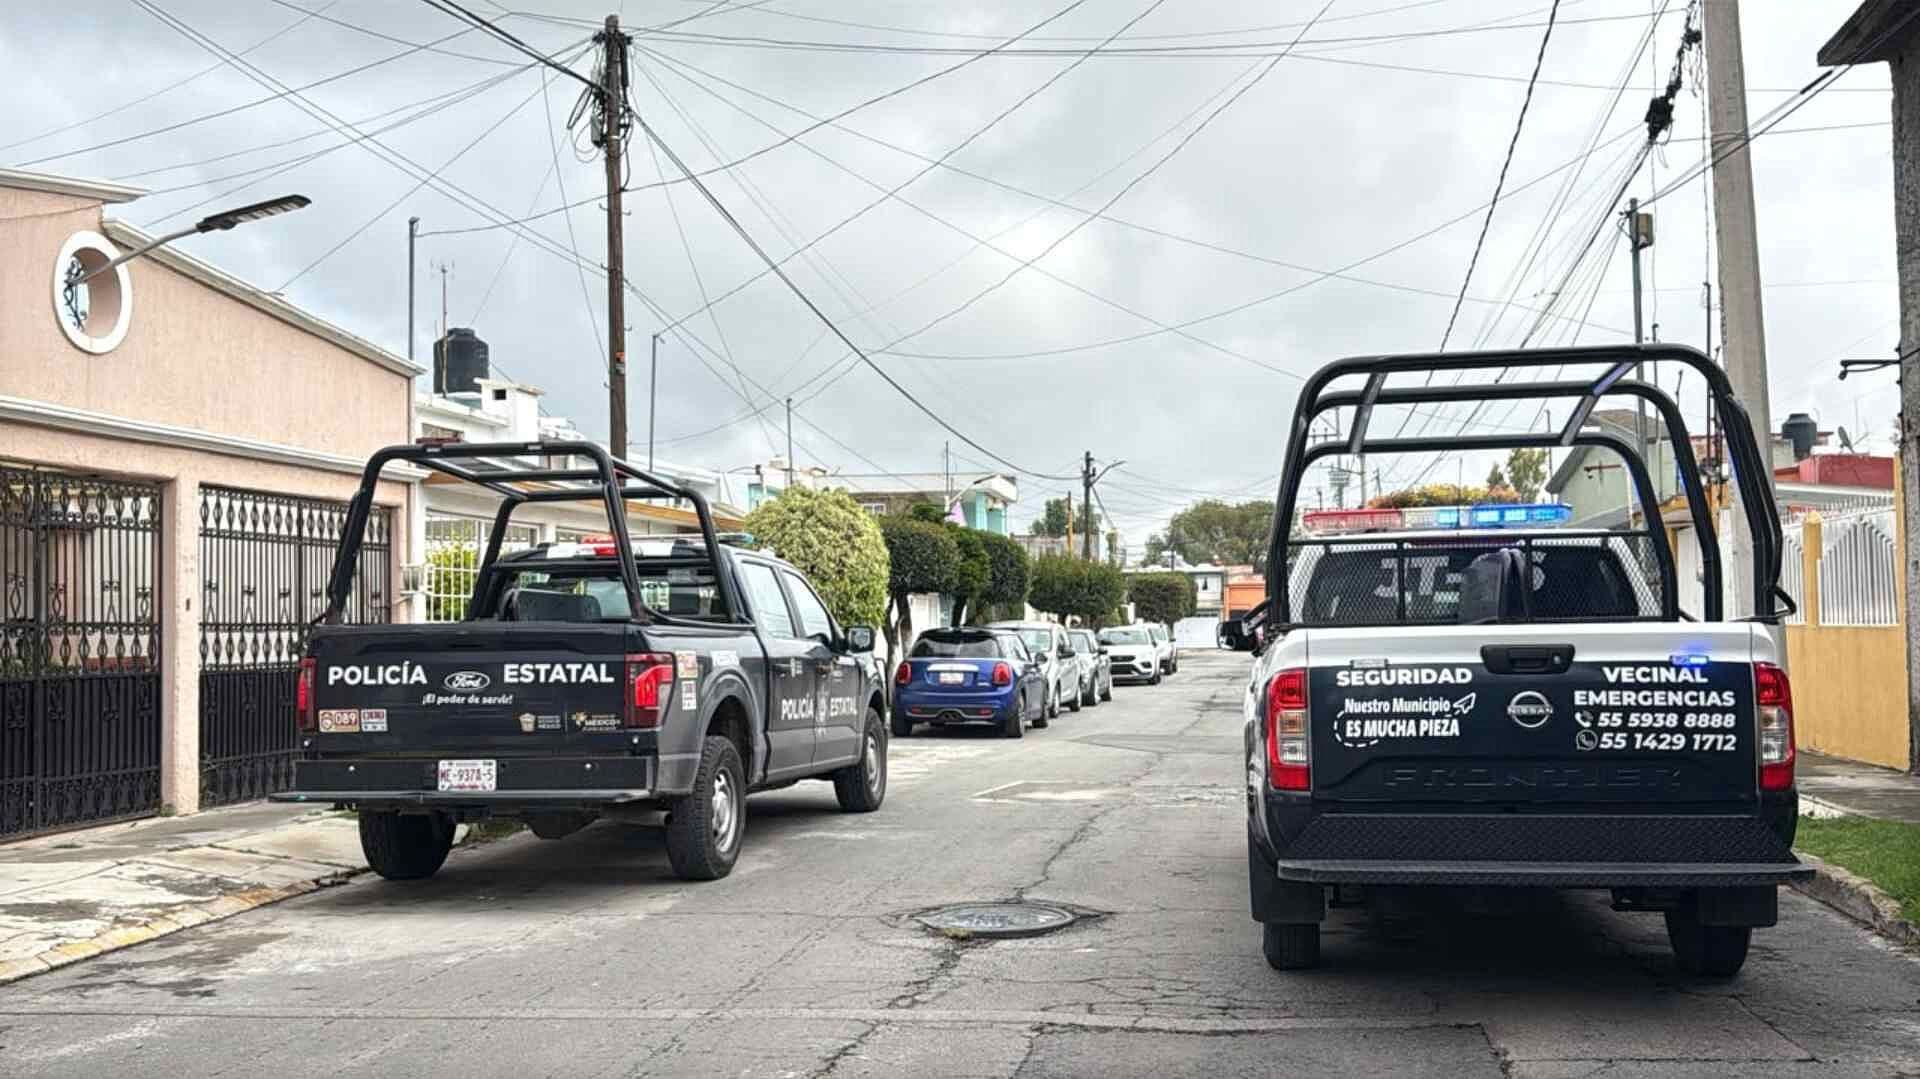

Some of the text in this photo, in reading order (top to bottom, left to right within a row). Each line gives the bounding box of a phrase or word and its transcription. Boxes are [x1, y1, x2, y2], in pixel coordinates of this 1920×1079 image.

[328, 660, 615, 686] POLICÍA ESTATAL
[451, 672, 482, 689] Ford
[1336, 667, 1708, 687] SEGURIDAD VECINAL
[436, 693, 467, 705] poder
[467, 693, 481, 704] de
[1344, 697, 1450, 716] Nuestro Municipio
[1574, 690, 1736, 707] EMERGENCIAS
[1507, 704, 1553, 716] NISSAN
[1345, 718, 1460, 738] ES MUCHA PIEZA
[1597, 711, 1736, 728] 55 5938 8888
[1600, 732, 1737, 751] 55 1429 1712
